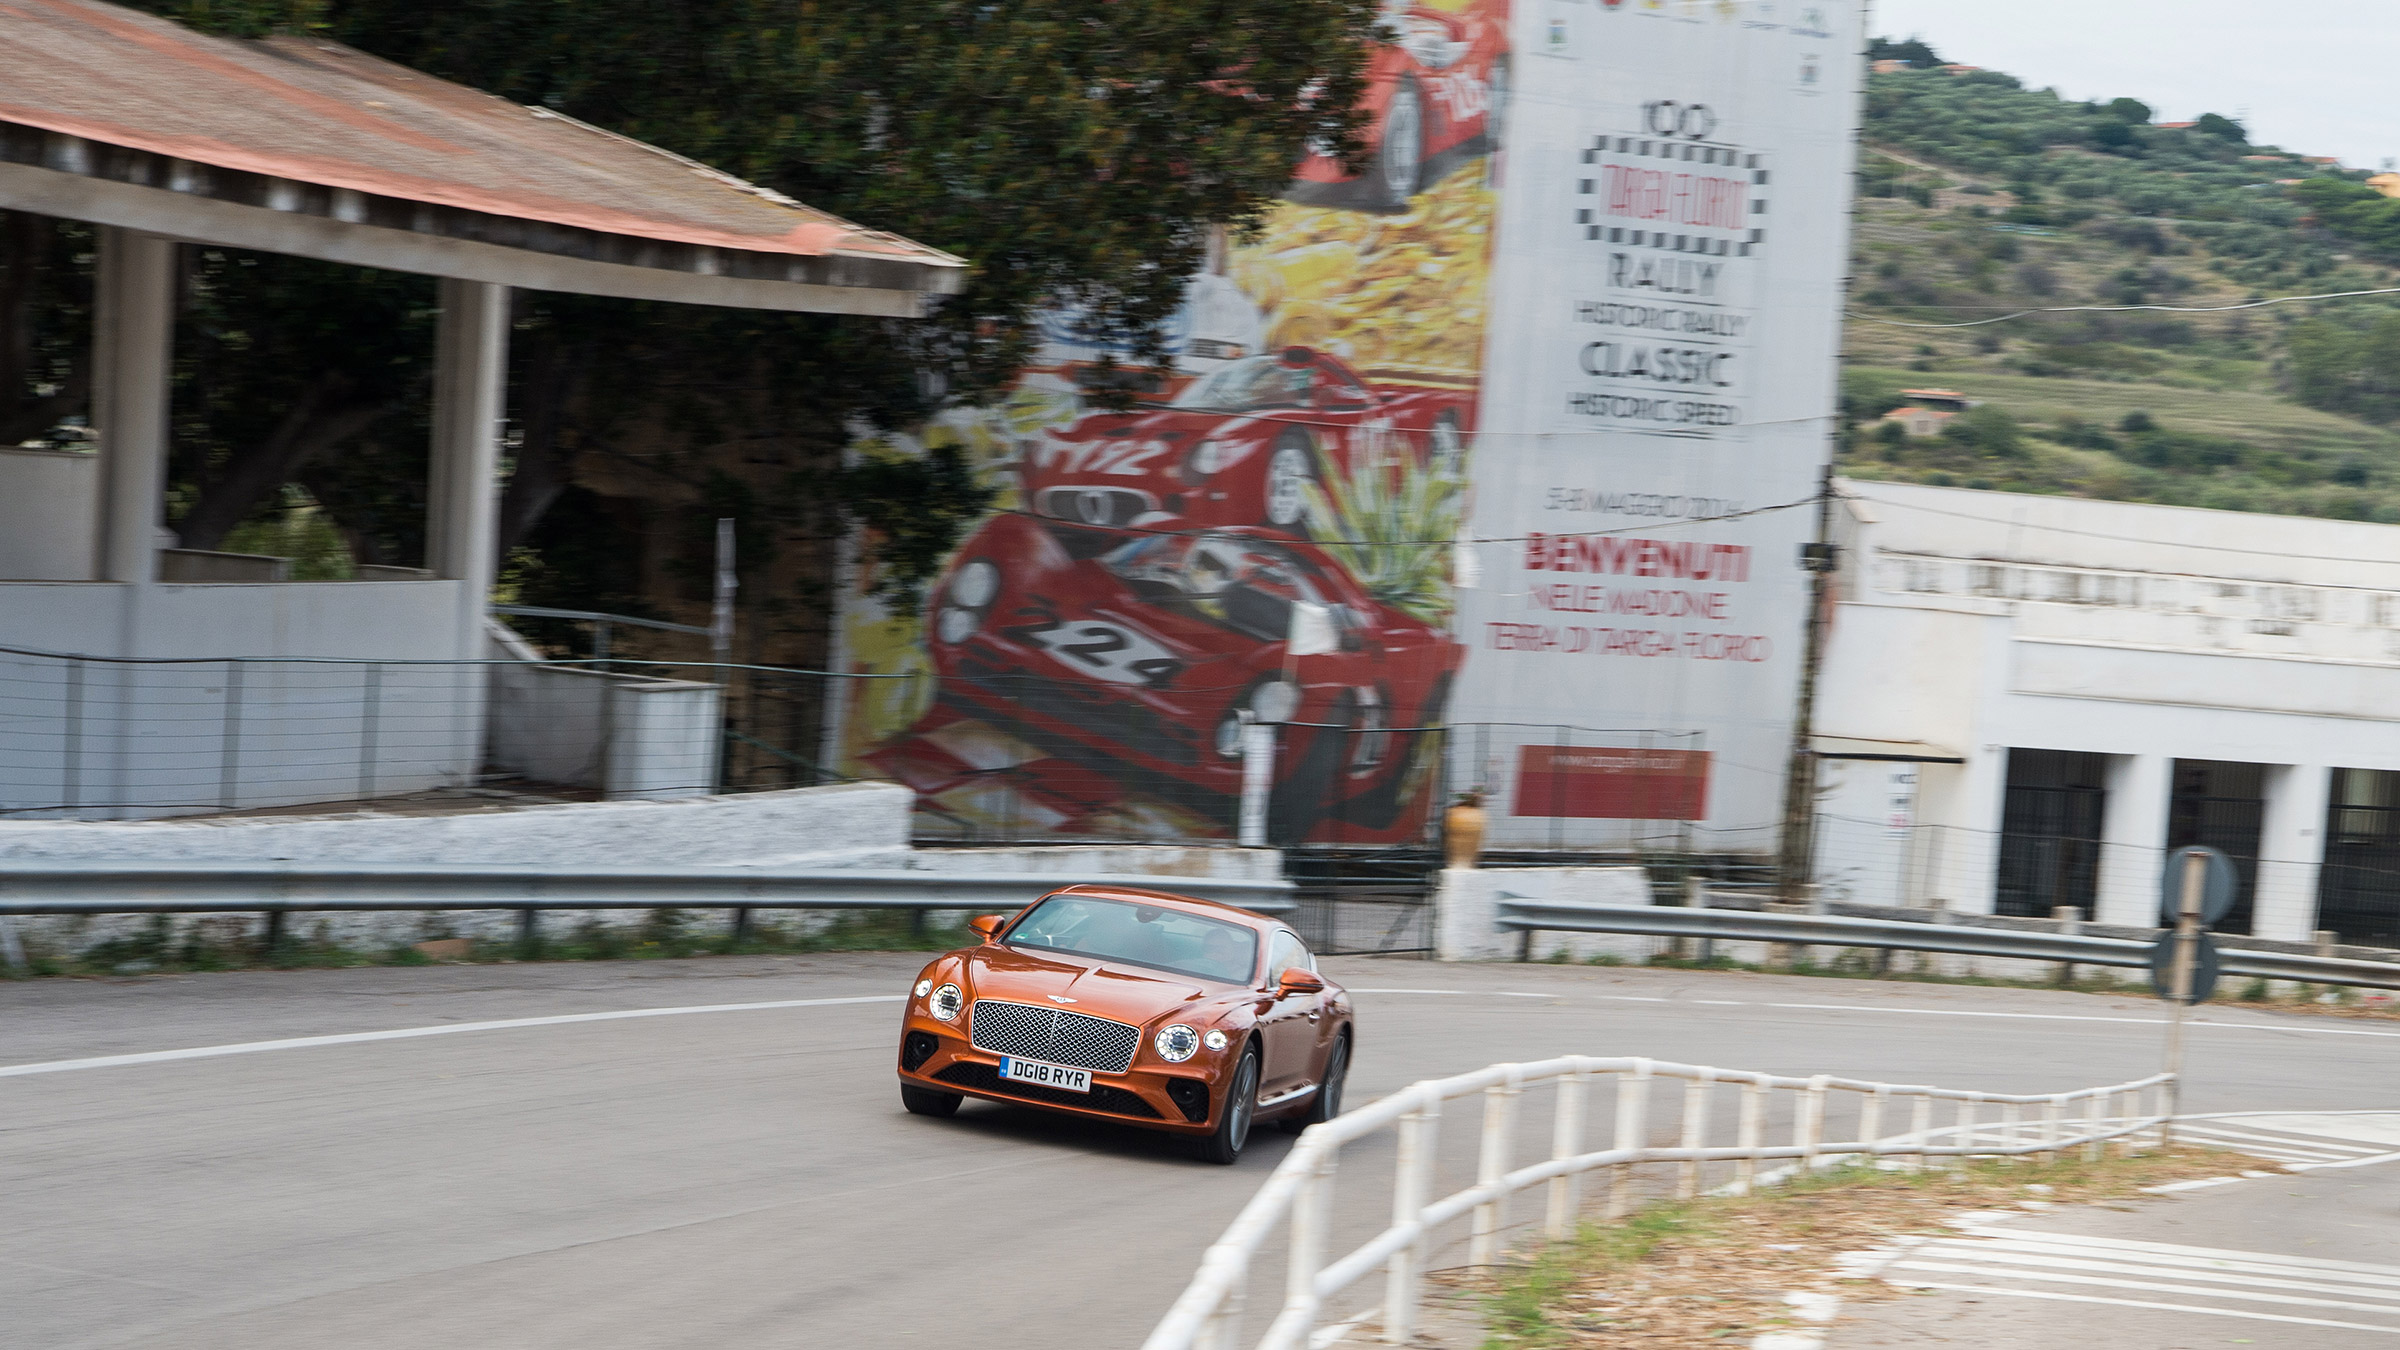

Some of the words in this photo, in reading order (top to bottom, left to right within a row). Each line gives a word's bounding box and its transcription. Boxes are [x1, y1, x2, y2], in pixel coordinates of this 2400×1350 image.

[1606, 252, 1725, 296] RALLY
[1573, 300, 1682, 331] HISTORIC
[1579, 341, 1737, 388] CLASSIC
[1564, 392, 1673, 422] HISTORIC
[1674, 401, 1743, 427] SPEED
[1524, 532, 1753, 583] BENVENUTI
[1013, 1061, 1049, 1082] DG18
[1052, 1068, 1085, 1088] RYR
